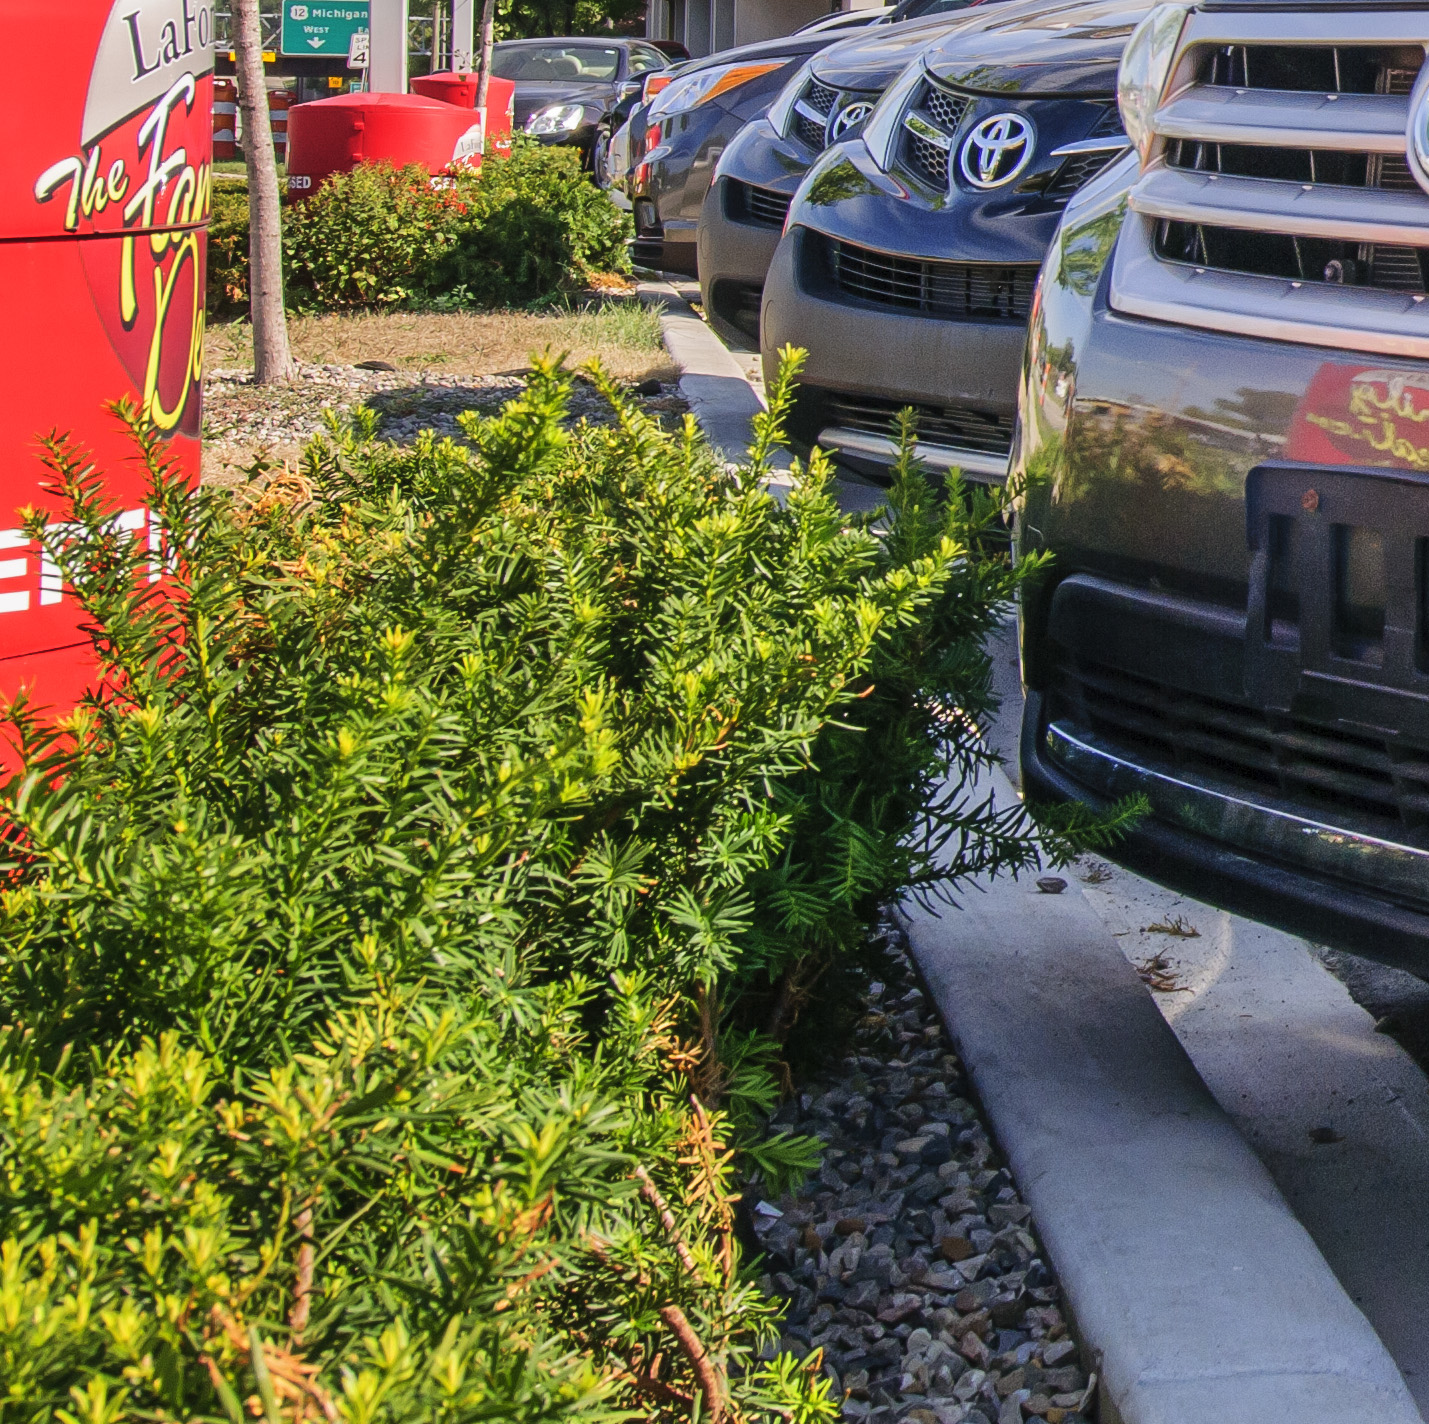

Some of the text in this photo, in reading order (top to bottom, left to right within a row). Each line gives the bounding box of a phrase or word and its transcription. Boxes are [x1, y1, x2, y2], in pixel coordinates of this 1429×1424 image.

[294, 8, 368, 20] 12 Michigan
[303, 26, 329, 34] WEST
[353, 52, 367, 64] 4
[35, 144, 129, 232] The
[288, 176, 311, 189] SED
